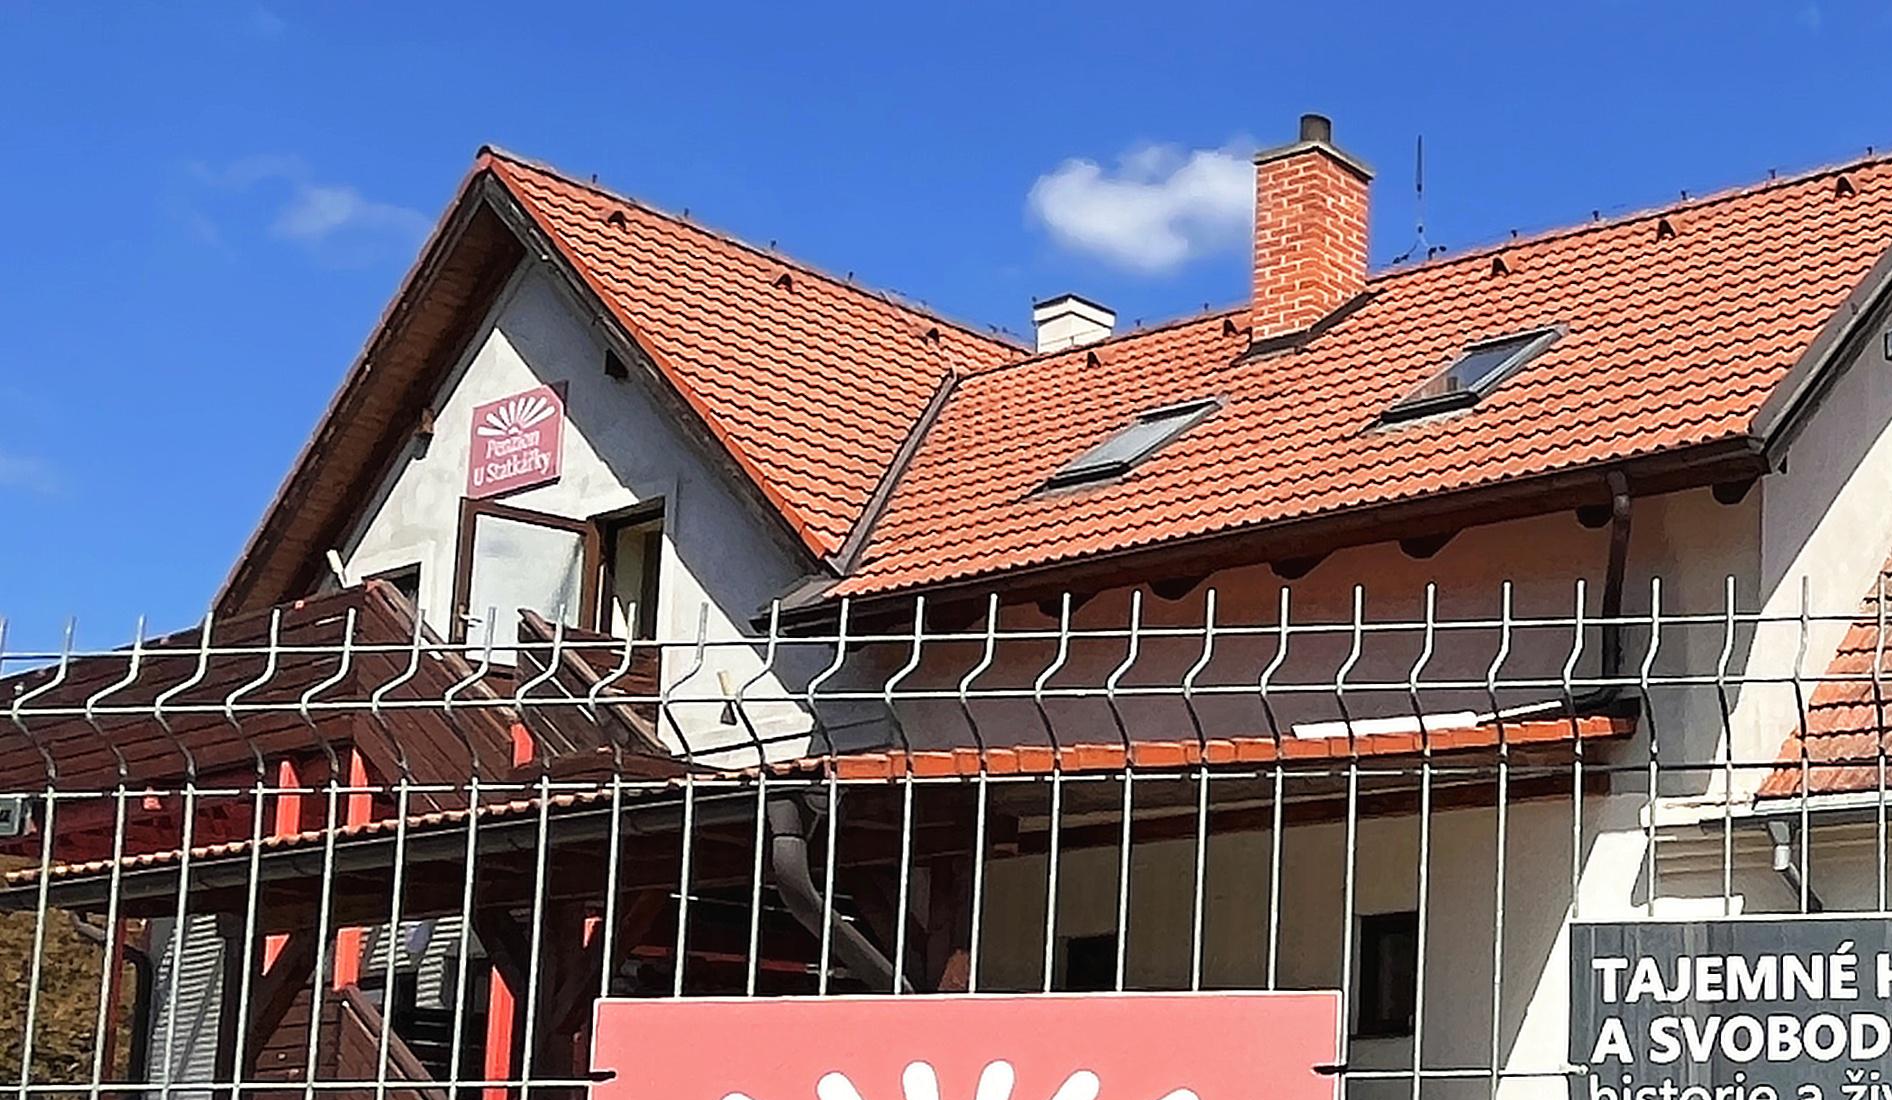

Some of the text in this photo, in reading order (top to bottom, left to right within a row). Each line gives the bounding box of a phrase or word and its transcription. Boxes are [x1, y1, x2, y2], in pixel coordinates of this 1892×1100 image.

[474, 466, 485, 487] U
[1591, 941, 1857, 1002] TAJEMNÉ
[1591, 1017, 1634, 1065] A
